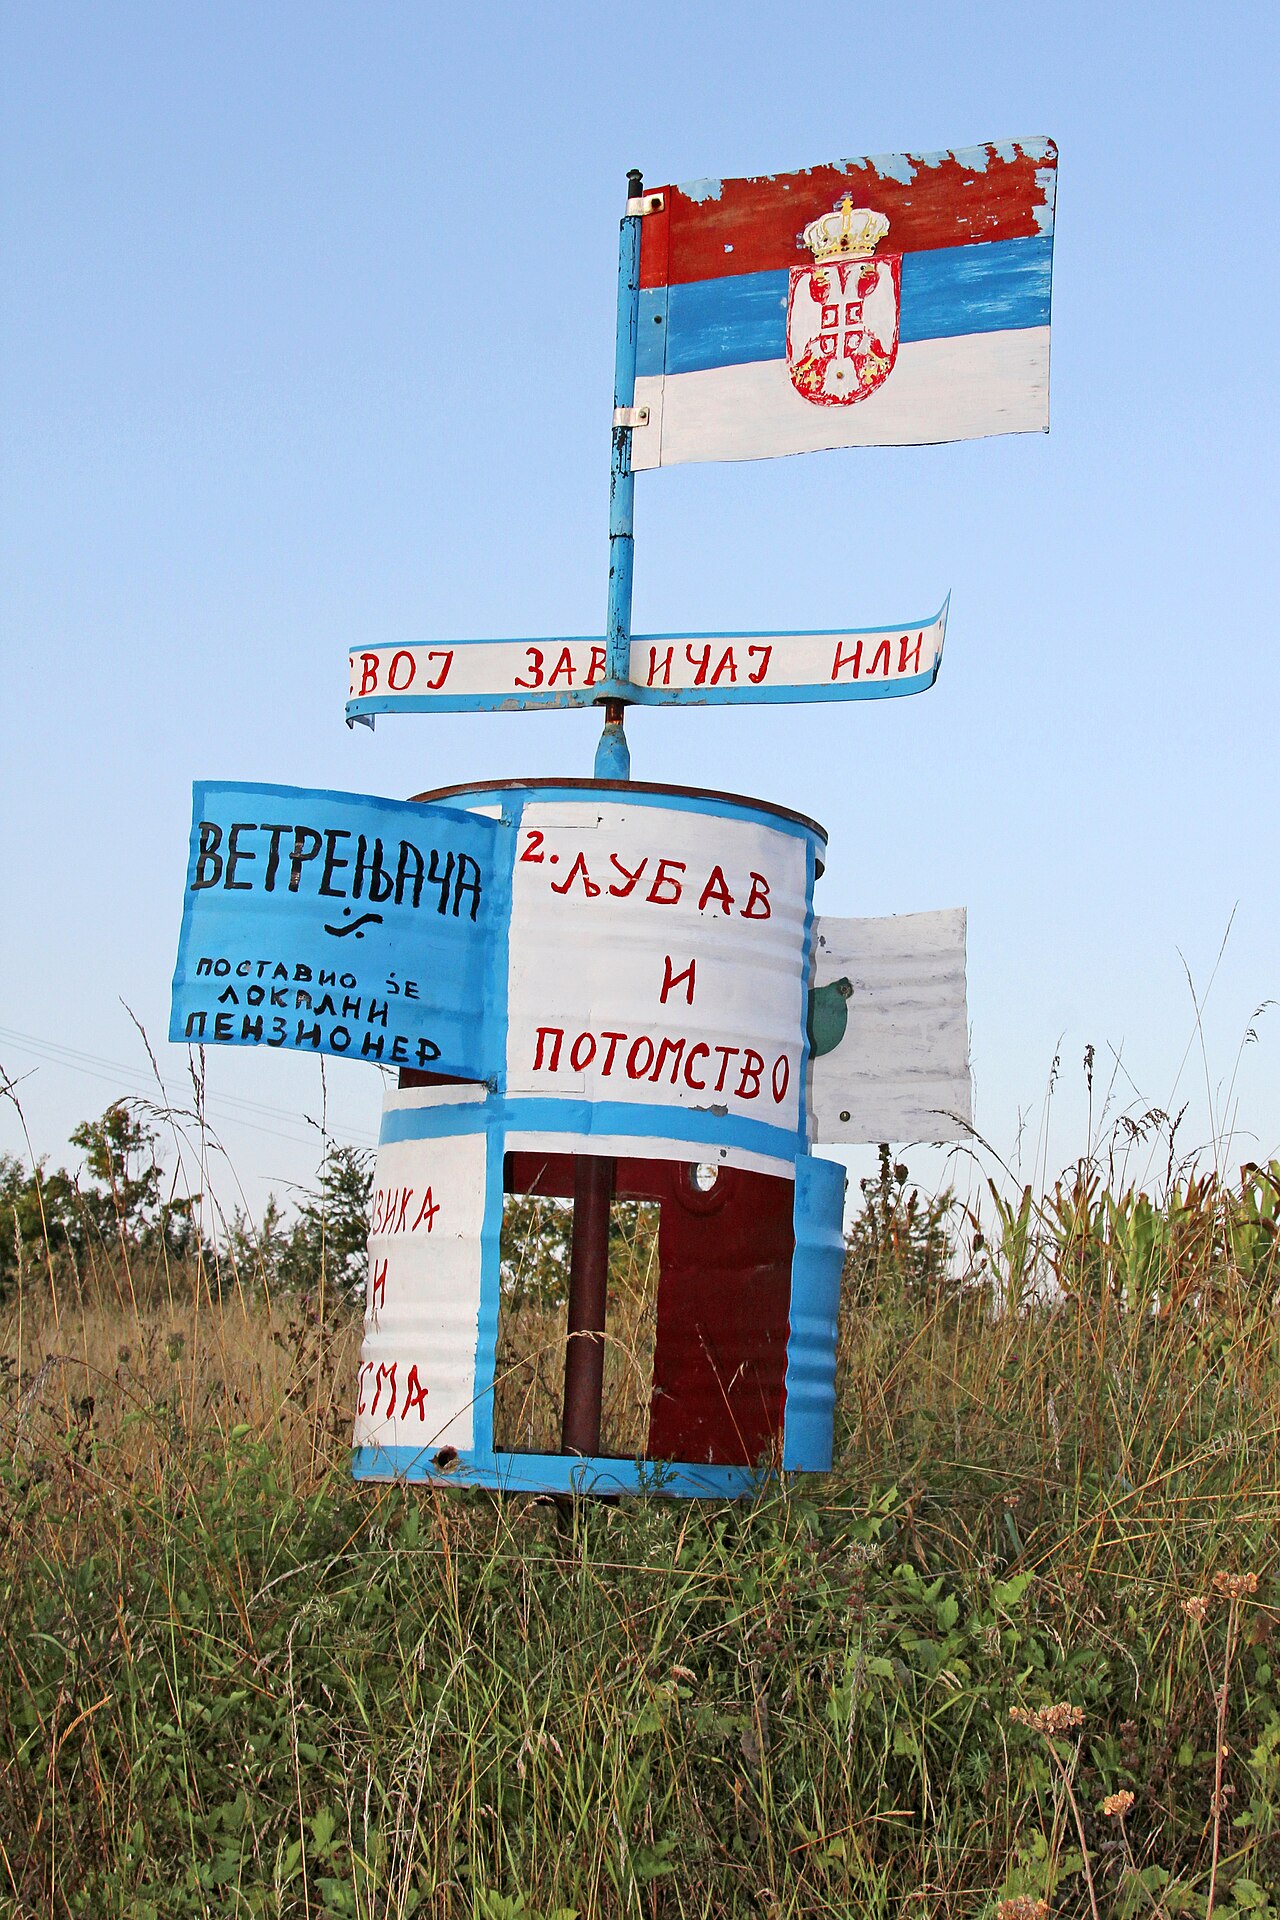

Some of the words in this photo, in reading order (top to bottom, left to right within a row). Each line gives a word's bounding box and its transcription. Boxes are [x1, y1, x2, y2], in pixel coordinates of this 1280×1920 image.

[349, 650, 454, 697] ВОЈ
[514, 643, 773, 689] ЗАВИЧАЈ
[831, 631, 924, 681] ИЛИ
[190, 821, 482, 922] ВЕТРЕЊАЧА
[520, 829, 560, 865] 2.
[550, 851, 771, 919] ЉУБАВ
[196, 957, 357, 989] ПОСТАВИО
[660, 955, 696, 1005] И
[217, 984, 389, 1027] ЛОКАЛНИ
[184, 1011, 442, 1067] ПЕНЗИОНЕР
[532, 1026, 789, 1103] ПОТОМСТВО
[372, 1258, 389, 1309] И
[357, 1359, 429, 1422] СМА
